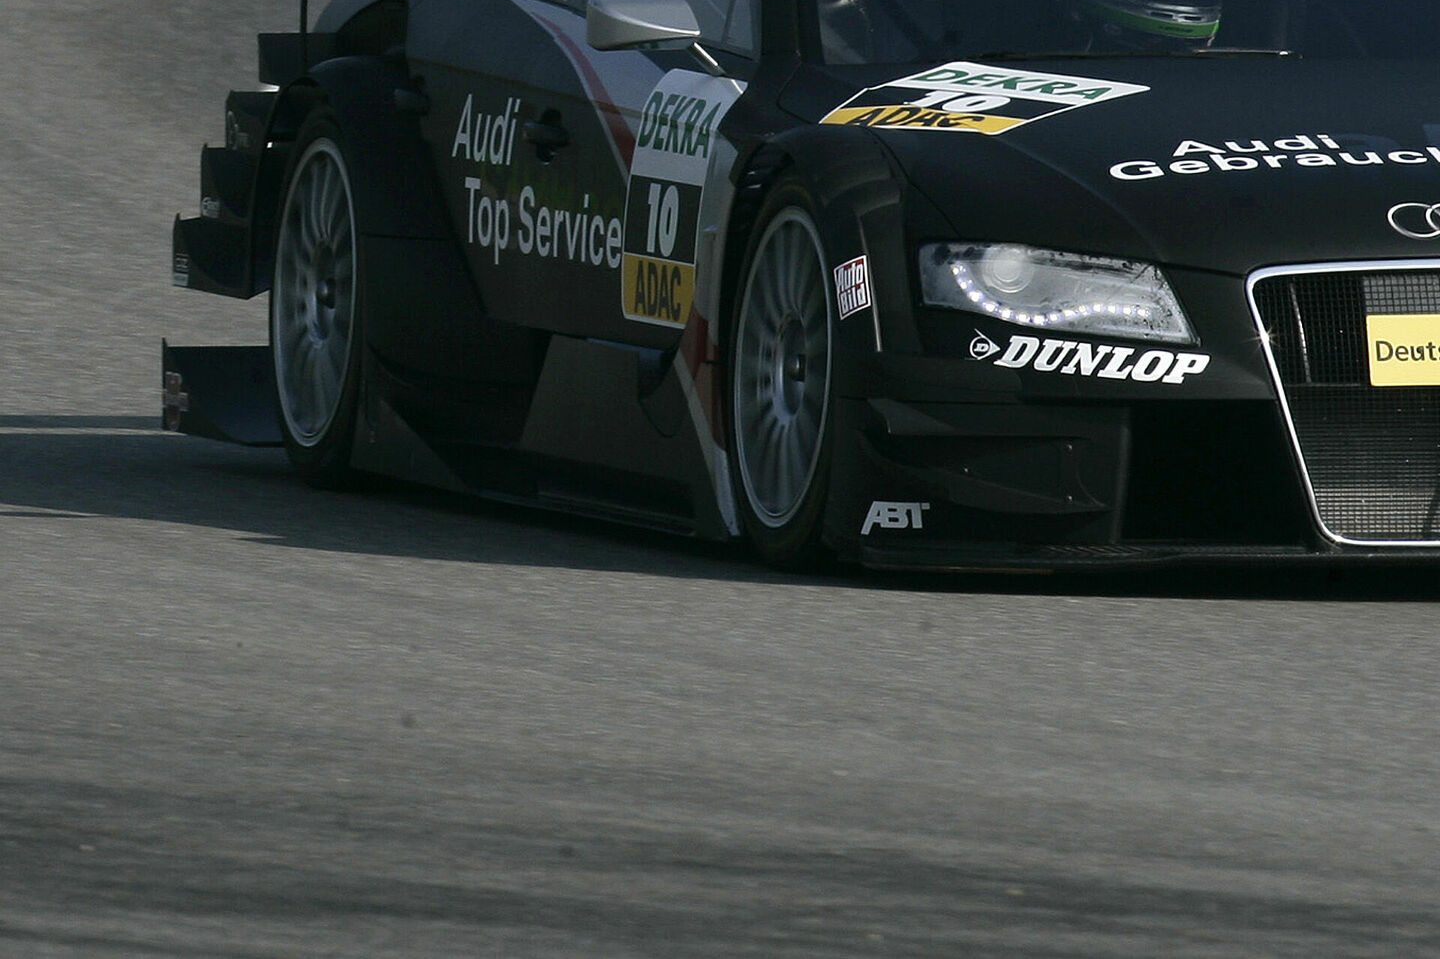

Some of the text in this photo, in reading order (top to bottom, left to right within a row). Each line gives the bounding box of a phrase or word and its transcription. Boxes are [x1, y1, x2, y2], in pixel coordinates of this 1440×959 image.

[904, 90, 1012, 113] 10
[911, 68, 1113, 100] DEKRA
[452, 93, 521, 166] Audi
[638, 91, 722, 158] DEKRA
[848, 107, 985, 128] ADAC
[1172, 134, 1341, 158] Audi
[465, 176, 622, 269] Top Service
[646, 183, 680, 257] 10
[634, 260, 682, 322] ADAC
[836, 262, 864, 293] Auto
[993, 335, 1211, 384] DUNLOP
[860, 500, 931, 535] ABT
